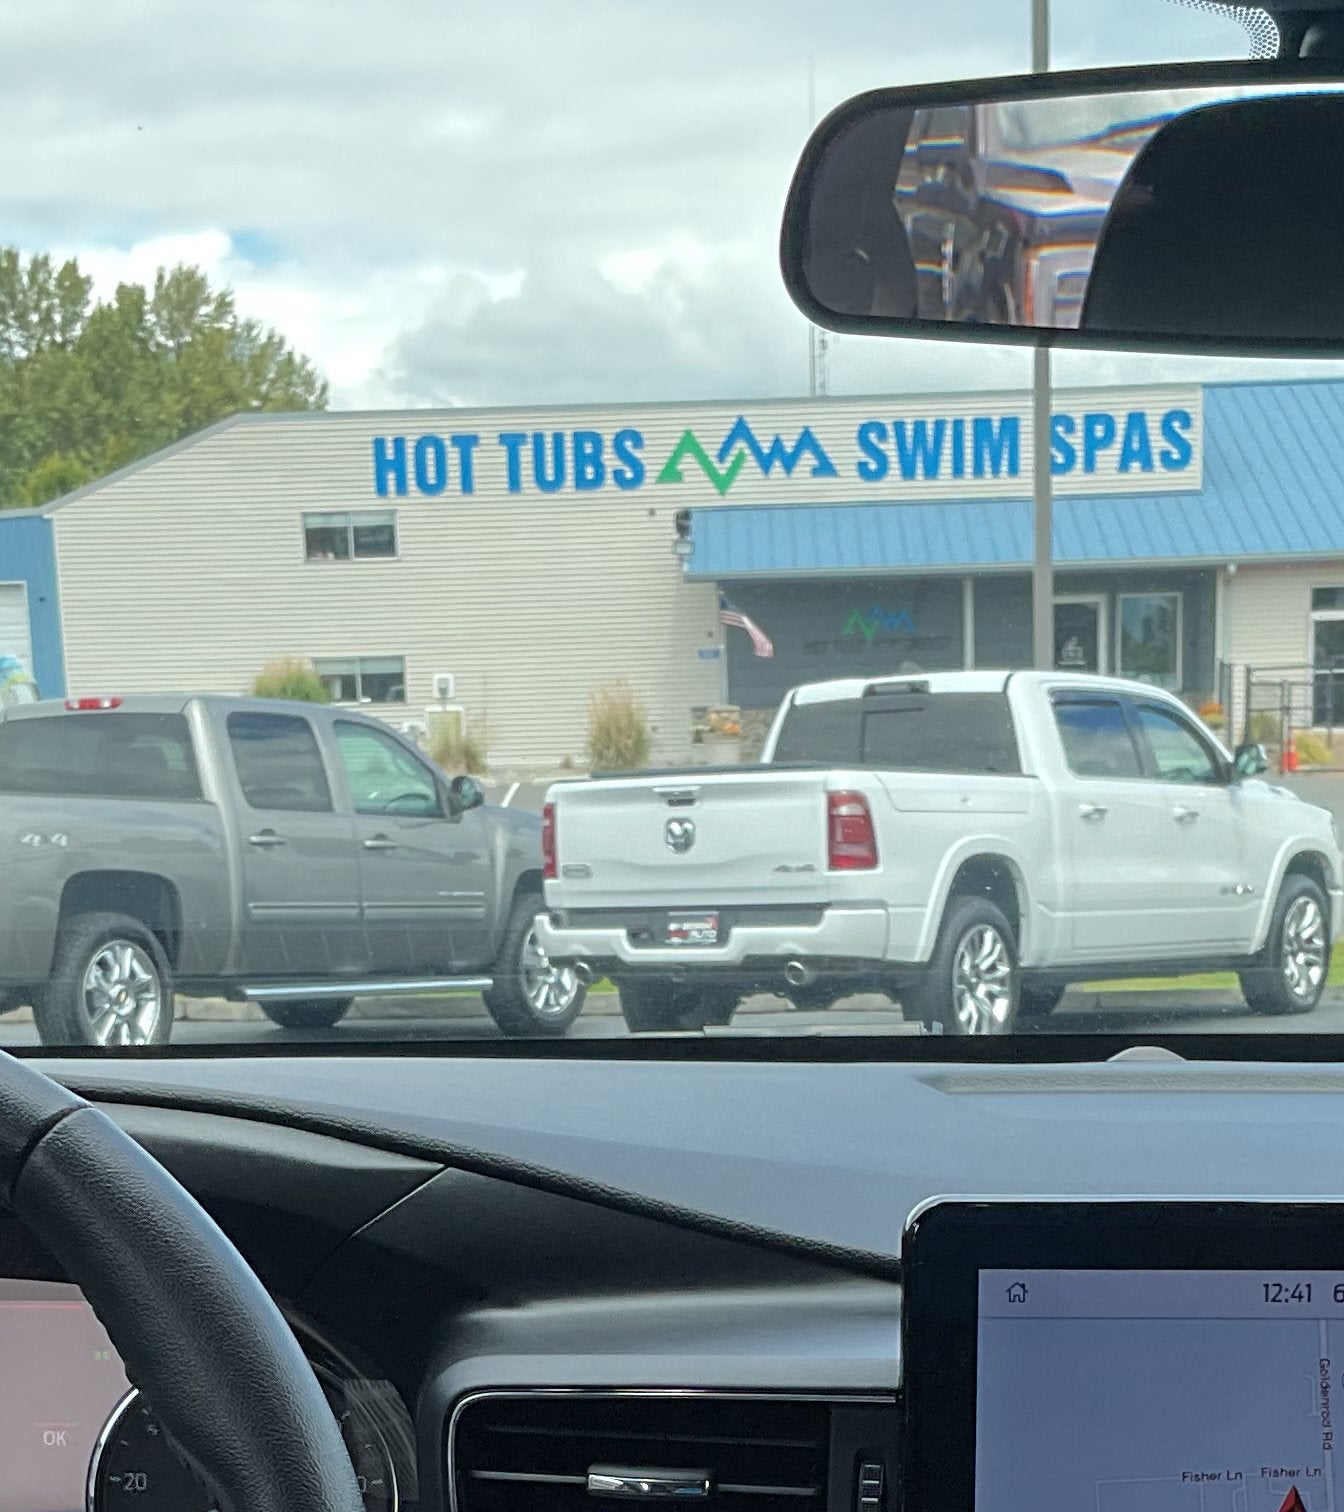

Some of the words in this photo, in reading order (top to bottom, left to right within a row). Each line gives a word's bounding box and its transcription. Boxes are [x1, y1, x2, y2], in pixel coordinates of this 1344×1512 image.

[373, 434, 479, 497] HOT
[499, 428, 646, 495] TUBS
[857, 416, 1020, 482] SWIM
[1049, 409, 1193, 477] SPAS
[1263, 1283, 1312, 1303] 12:41
[1319, 1358, 1332, 1428] Goldenrod
[43, 1430, 67, 1447] OK
[1322, 1432, 1333, 1450] Rd
[123, 1472, 147, 1490] 20
[1182, 1471, 1222, 1482] Fisher
[1227, 1470, 1243, 1481] Ln
[1261, 1467, 1301, 1478] Fisher
[1306, 1467, 1322, 1477] Ln
